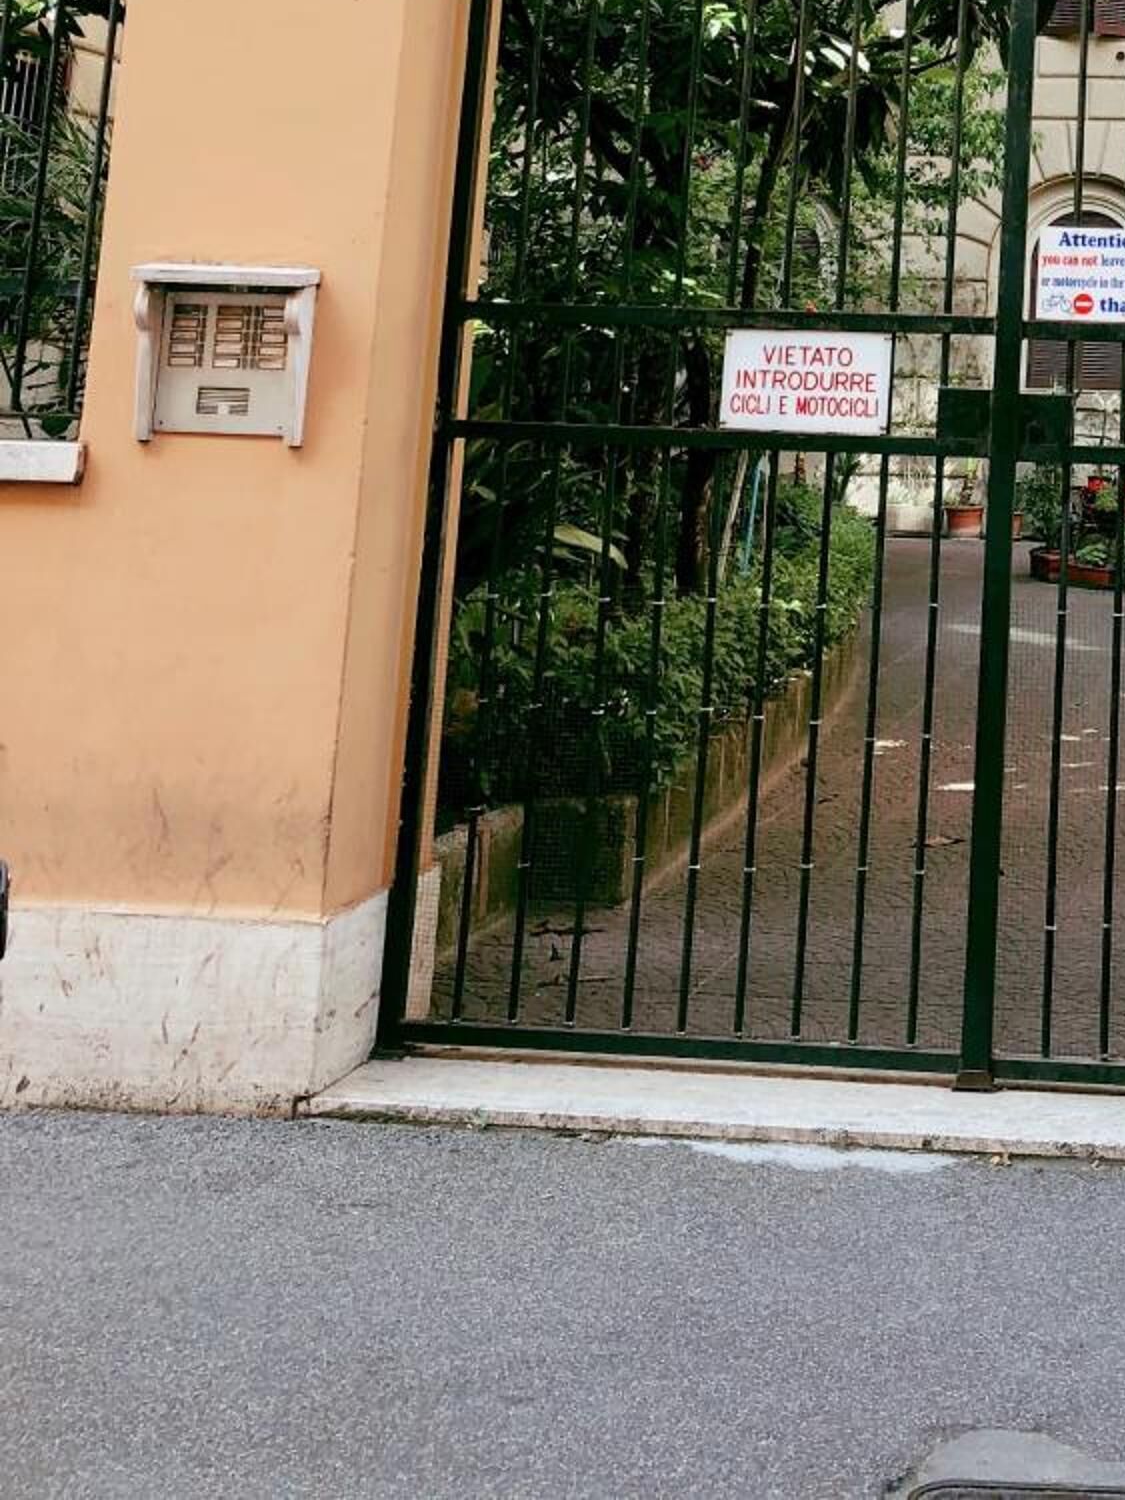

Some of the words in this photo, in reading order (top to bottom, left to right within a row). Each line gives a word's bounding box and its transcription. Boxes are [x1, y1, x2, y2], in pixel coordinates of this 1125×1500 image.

[1042, 255, 1060, 267] you
[1062, 256, 1079, 266] can
[1082, 256, 1098, 266] not
[1101, 254, 1125, 267] leave
[1041, 277, 1050, 287] or
[1052, 276, 1097, 290] motorcycle
[1099, 277, 1108, 288] in
[1111, 277, 1123, 288] the
[762, 345, 853, 367] VIETATO
[736, 369, 877, 392] INTRODURRE
[730, 393, 771, 415] CICLI
[779, 396, 788, 415] E
[795, 396, 879, 417] MOTOCICLI
